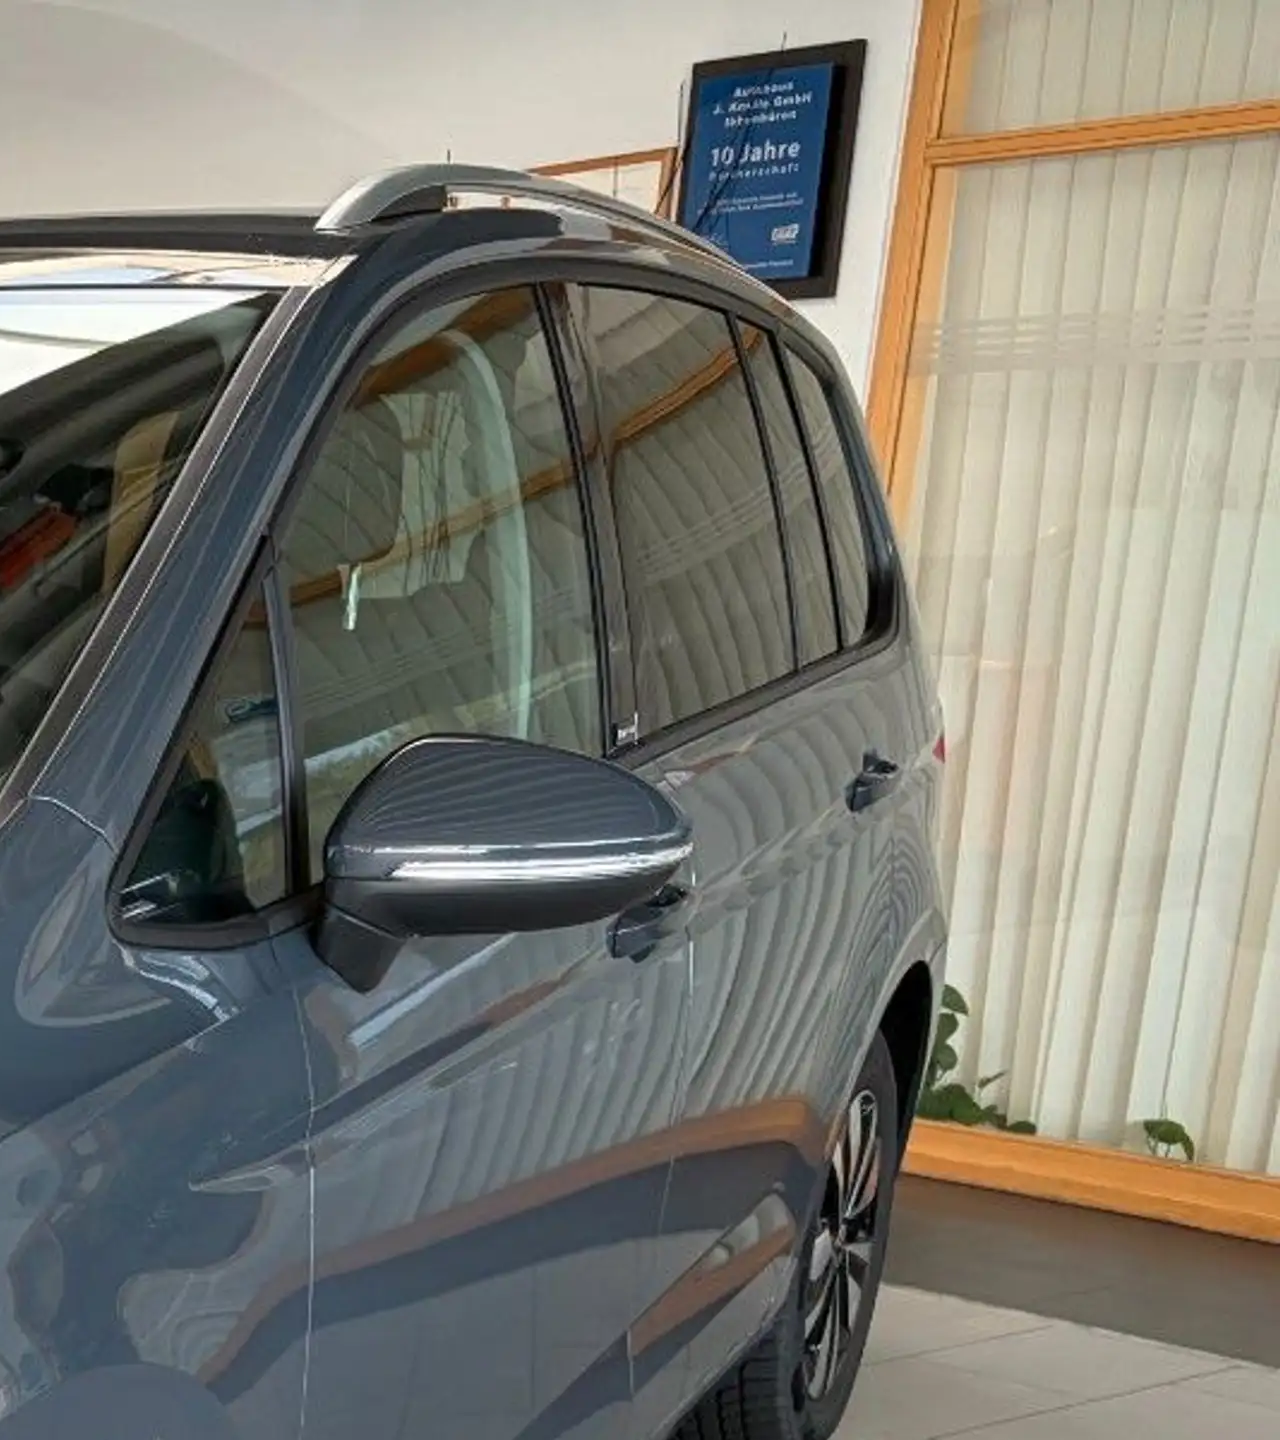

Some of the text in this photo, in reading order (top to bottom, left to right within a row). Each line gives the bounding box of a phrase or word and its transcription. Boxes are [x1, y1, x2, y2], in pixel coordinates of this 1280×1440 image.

[773, 90, 814, 108] GmbH
[711, 138, 801, 167] 10 Jahre
